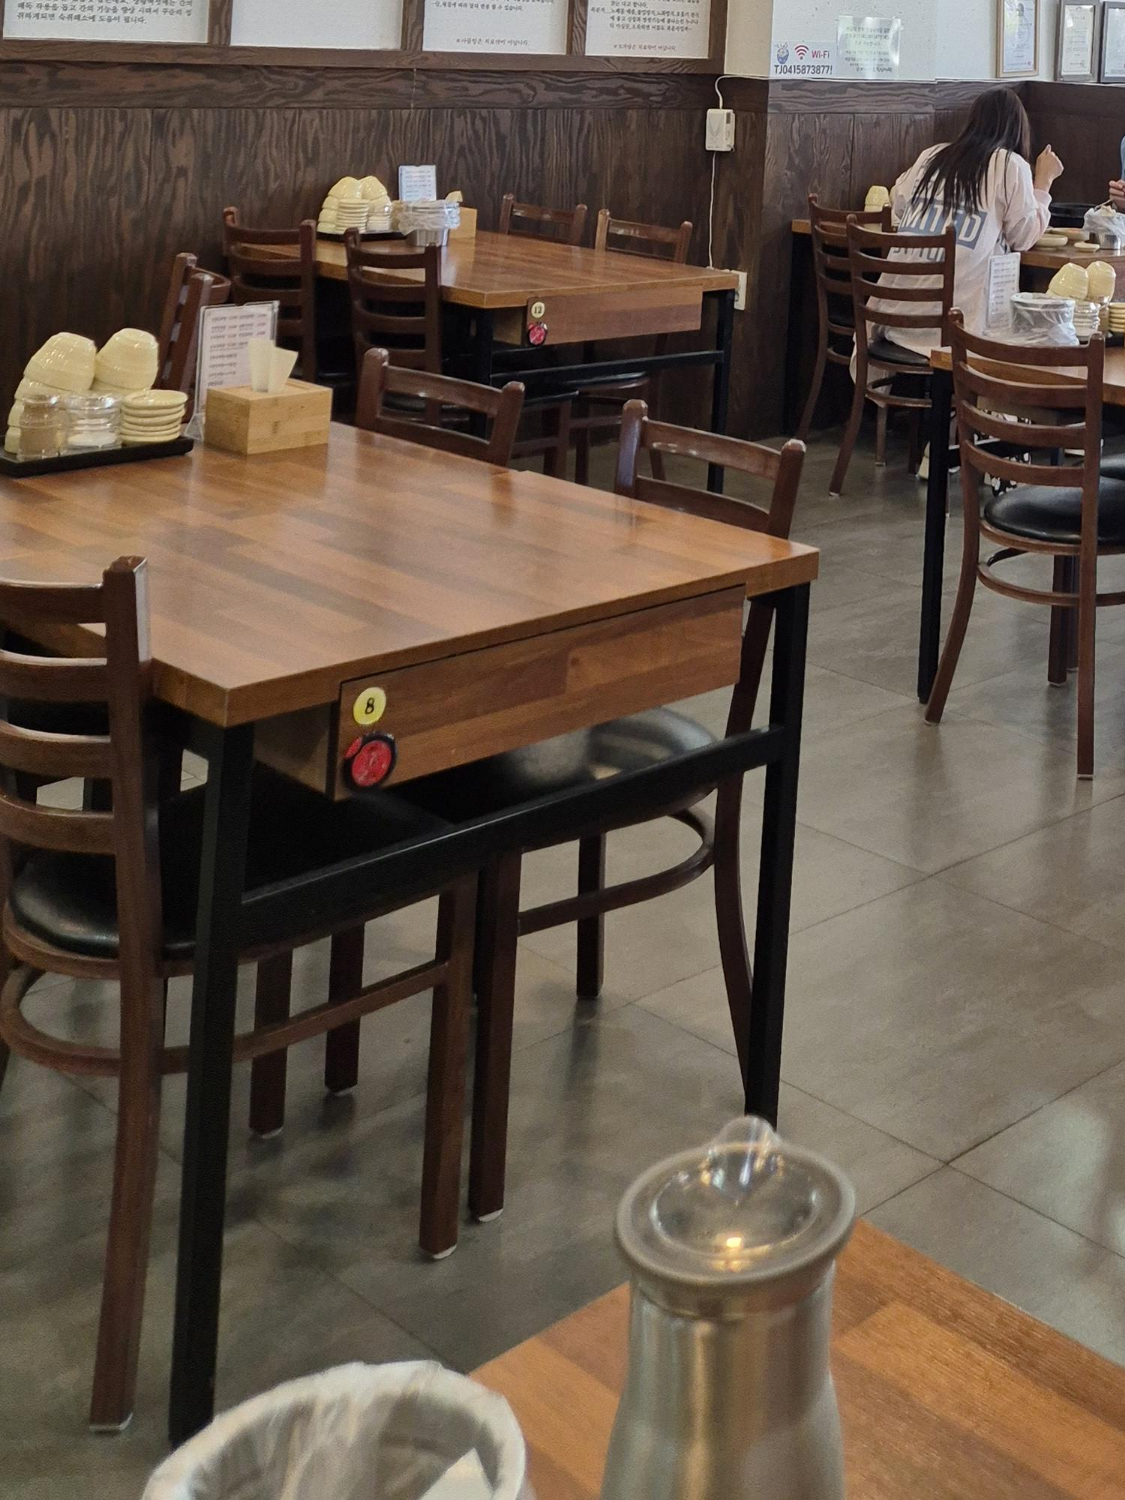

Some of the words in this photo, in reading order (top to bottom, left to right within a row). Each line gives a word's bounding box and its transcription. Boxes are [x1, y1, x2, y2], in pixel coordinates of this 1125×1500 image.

[812, 50, 830, 59] Wi-Fi
[534, 306, 543, 314] 12
[365, 697, 375, 714] 8
